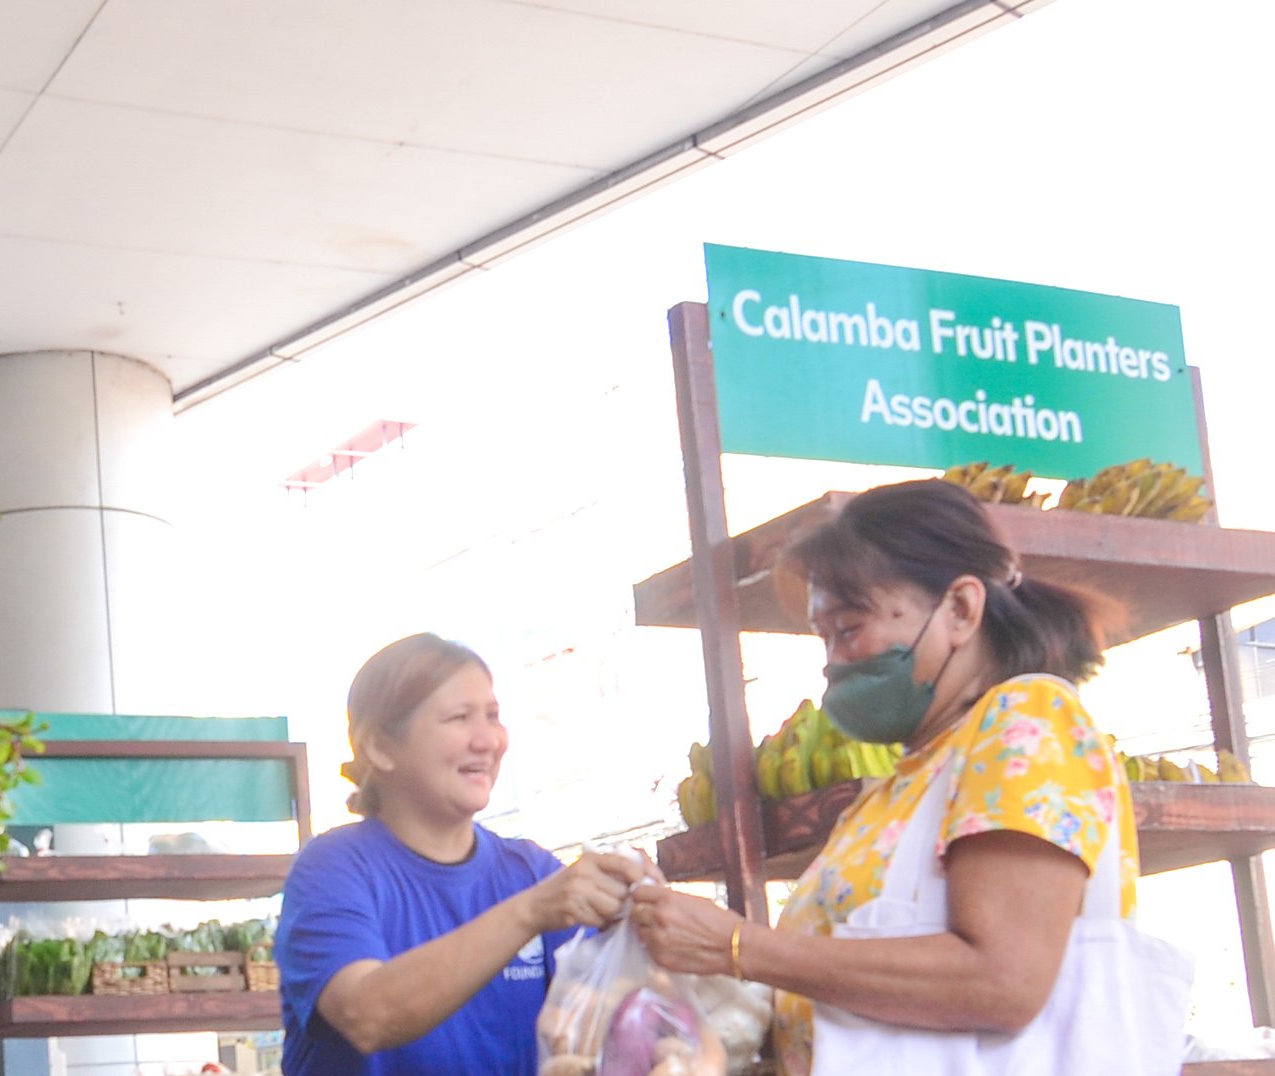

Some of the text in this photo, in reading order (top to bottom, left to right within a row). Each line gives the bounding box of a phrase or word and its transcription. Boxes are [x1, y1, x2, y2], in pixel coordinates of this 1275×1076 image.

[731, 289, 1172, 382] Calamba Fruit Planters
[860, 379, 1083, 444] Association
